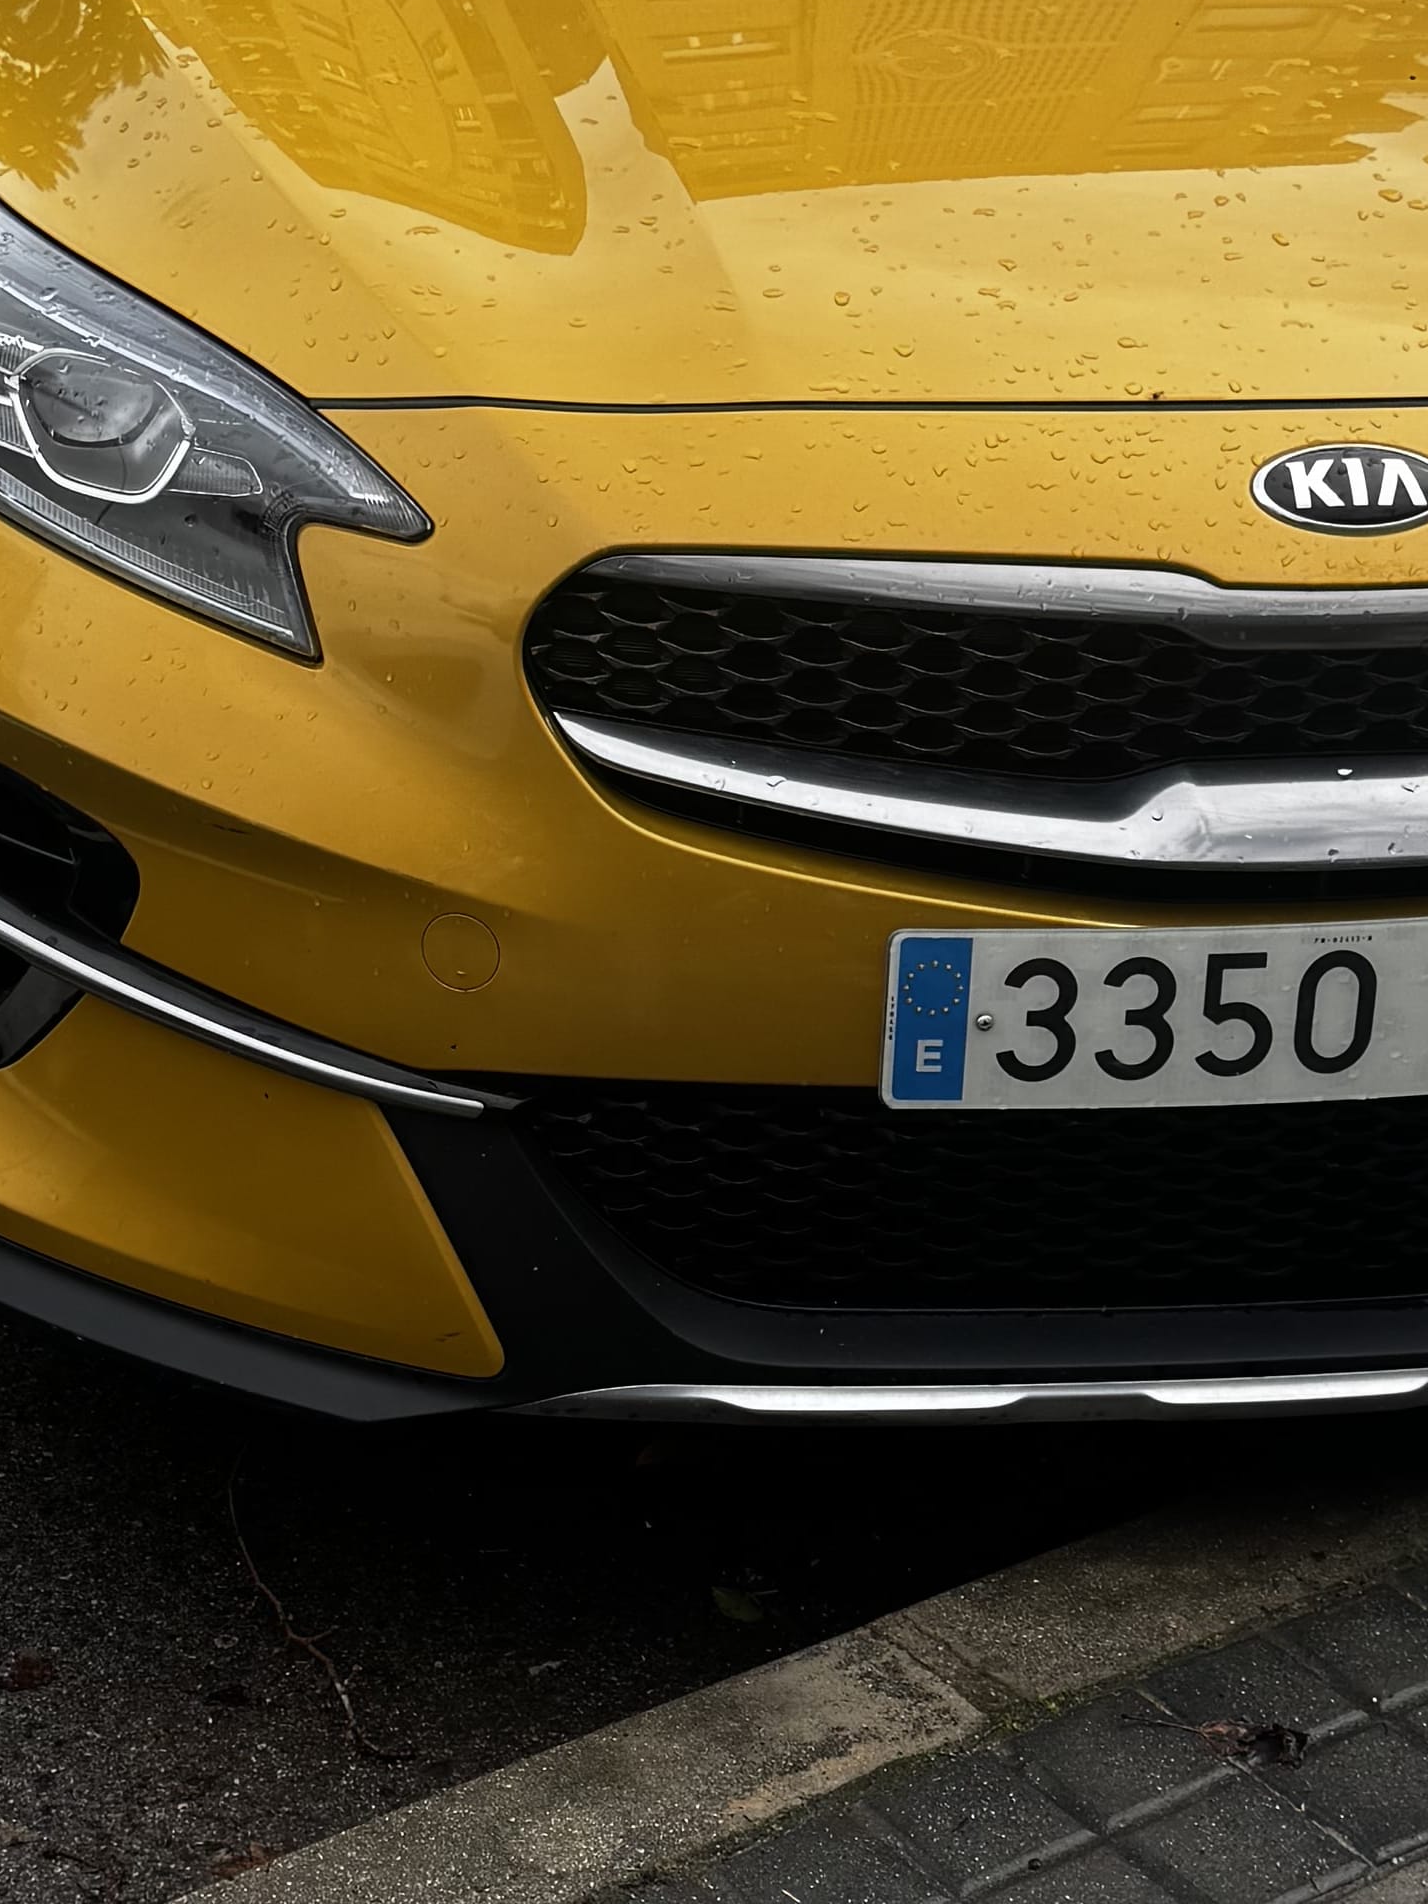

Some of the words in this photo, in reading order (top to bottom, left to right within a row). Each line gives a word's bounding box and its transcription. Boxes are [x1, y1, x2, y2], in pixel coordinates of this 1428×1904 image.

[1284, 456, 1428, 510] KIA
[995, 949, 1378, 1083] 3350
[915, 1039, 944, 1073] E
